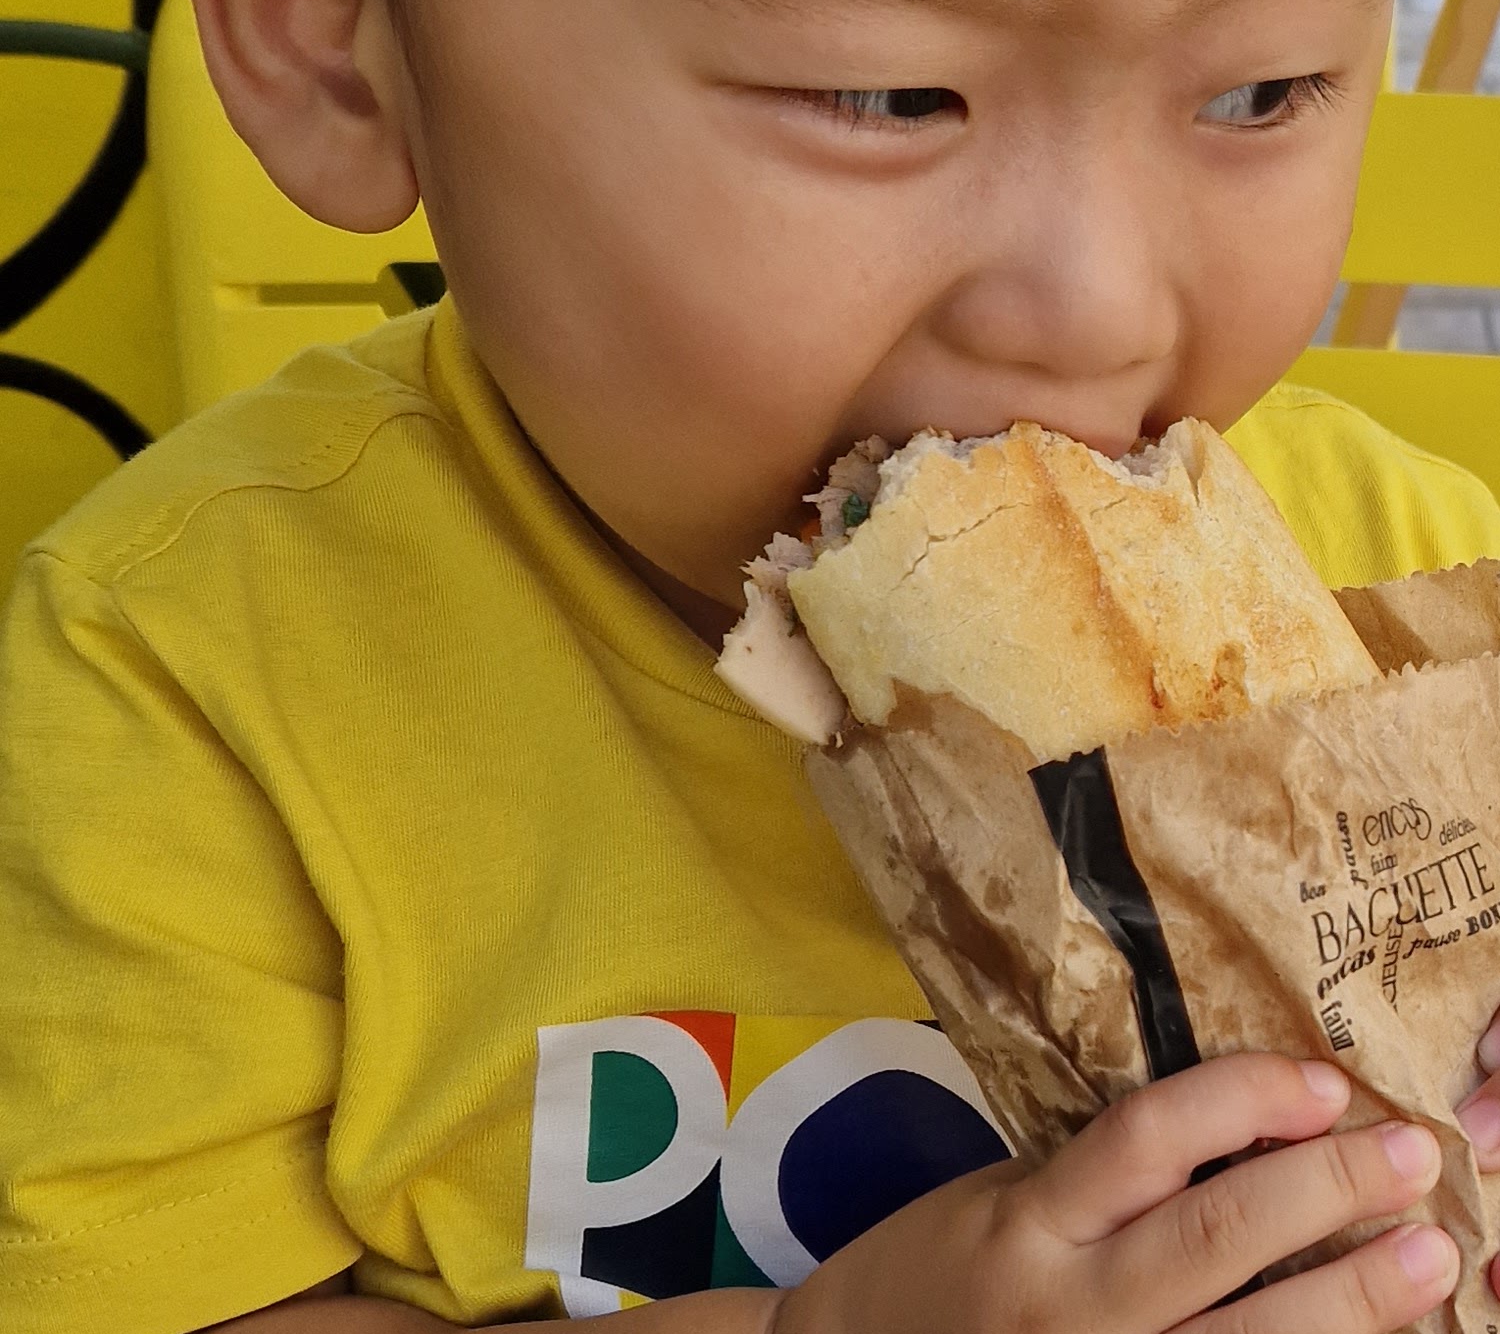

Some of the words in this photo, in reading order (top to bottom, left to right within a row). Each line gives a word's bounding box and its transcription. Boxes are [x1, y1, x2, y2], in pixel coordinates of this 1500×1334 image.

[1403, 928, 1461, 959] pause
[1321, 1000, 1355, 1052] faim
[525, 1014, 1016, 1287] PO
